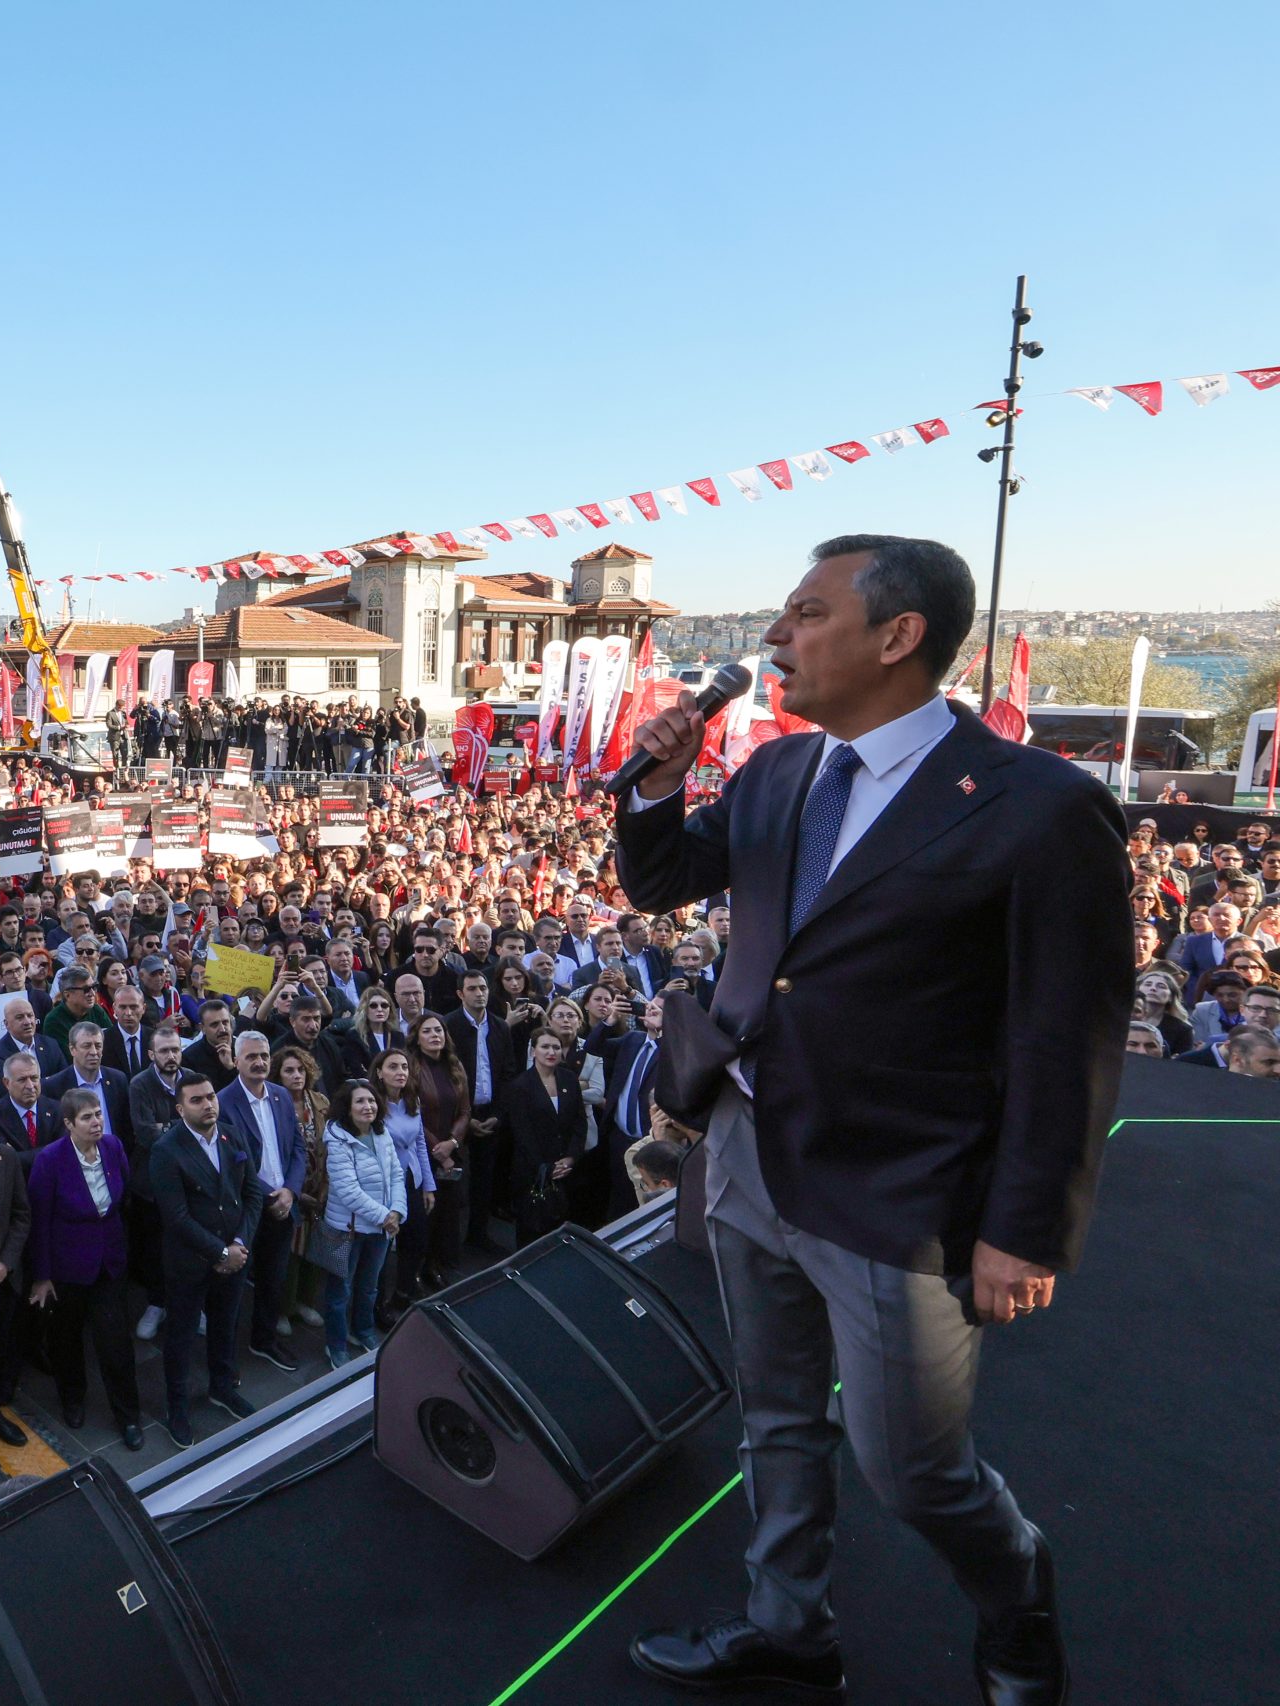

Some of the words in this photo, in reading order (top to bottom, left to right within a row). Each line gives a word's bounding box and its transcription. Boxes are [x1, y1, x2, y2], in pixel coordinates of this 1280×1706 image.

[567, 672, 587, 758] SARIYER
[330, 812, 365, 821] UNUTMA!
[221, 820, 255, 830] UNUTMA!
[58, 835, 93, 848] UNUTMA!
[155, 835, 190, 844] UNUTMA!
